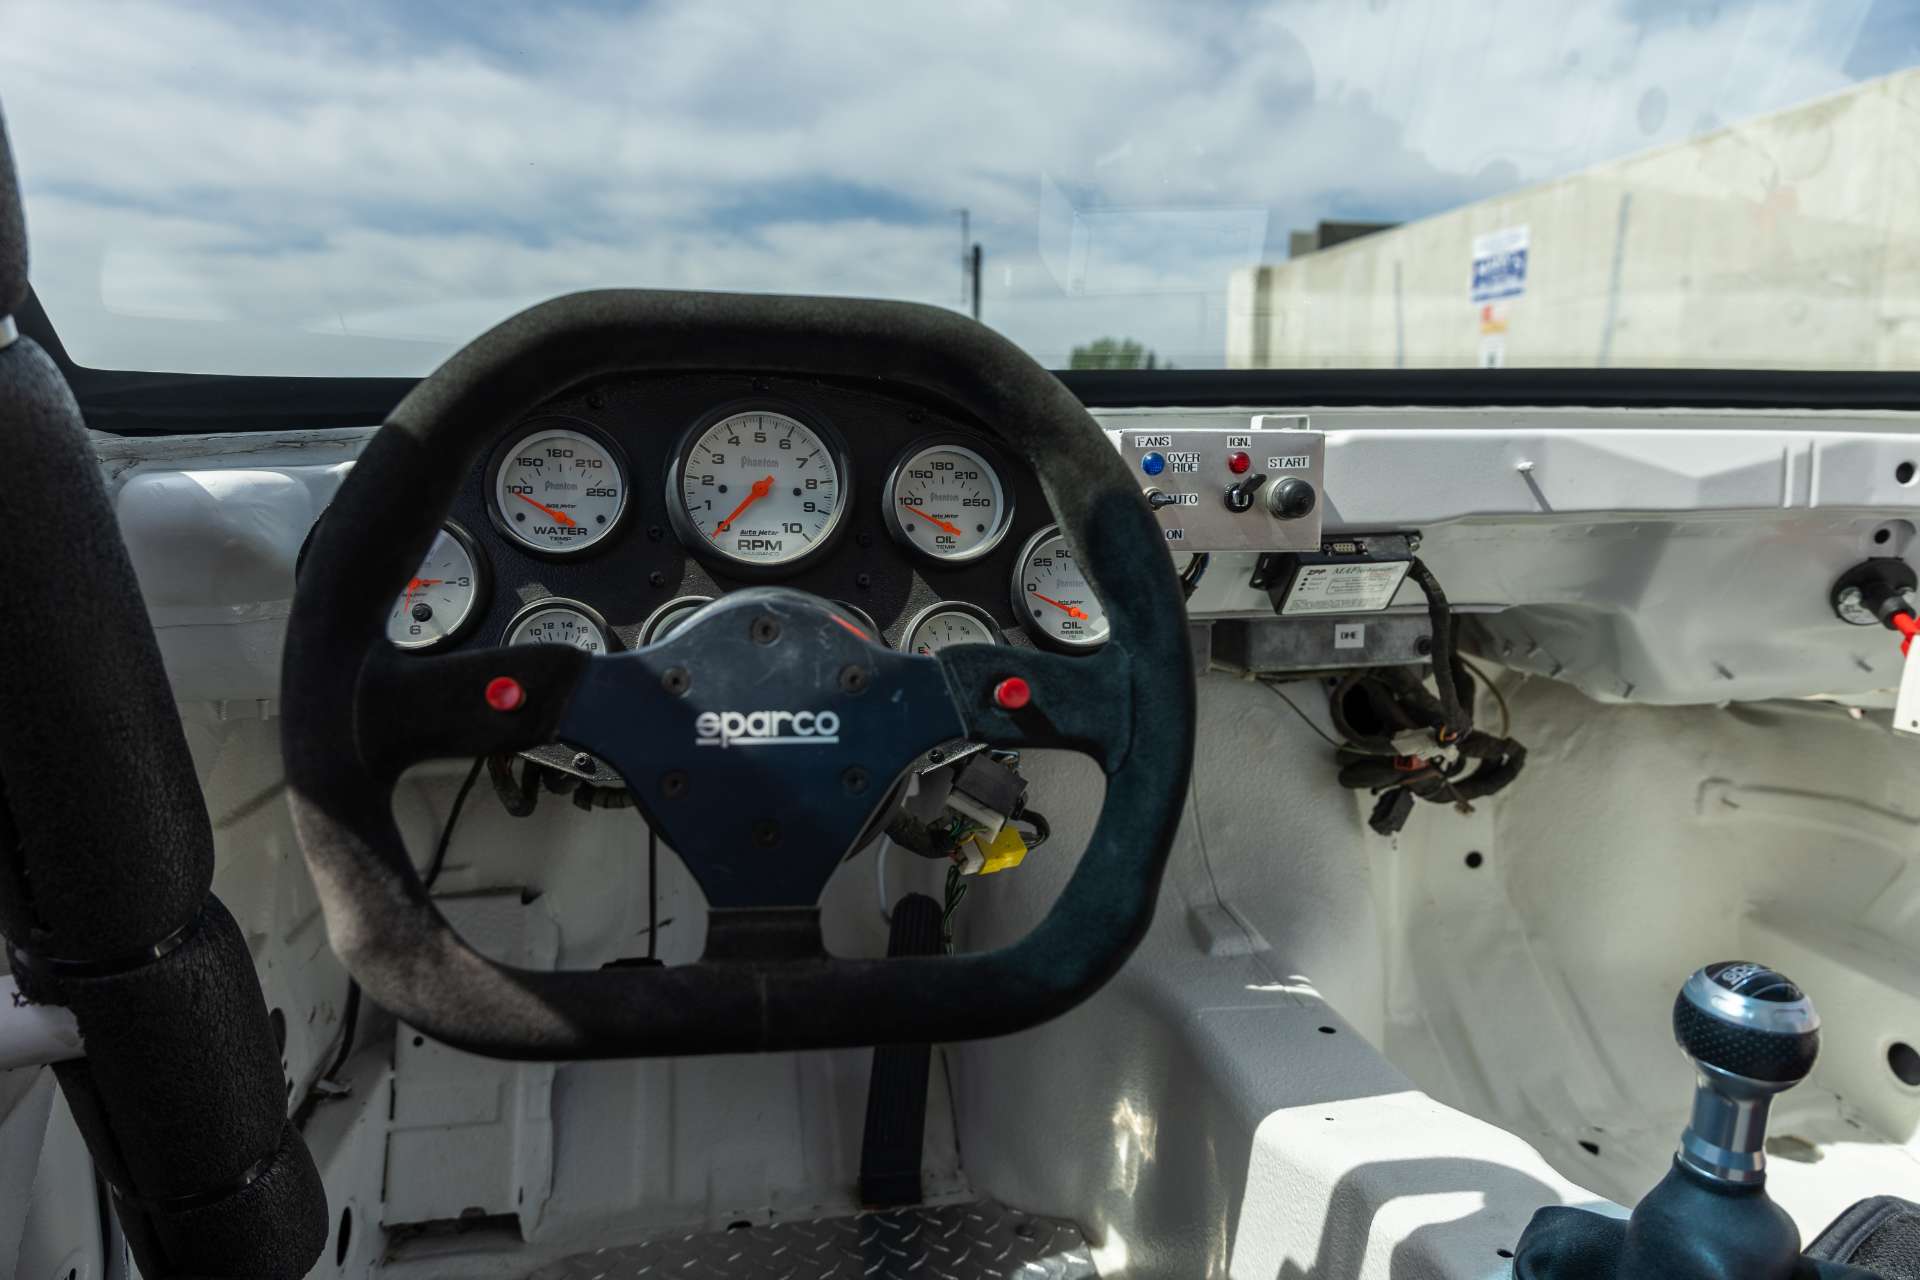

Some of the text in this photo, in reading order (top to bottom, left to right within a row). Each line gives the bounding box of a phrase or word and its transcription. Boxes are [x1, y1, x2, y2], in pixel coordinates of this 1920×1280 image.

[728, 435, 741, 446] 4
[754, 432, 767, 443] 5
[1136, 436, 1170, 447] FANS
[1229, 437, 1251, 448] IGN.
[779, 439, 791, 450] 6
[546, 448, 574, 458] 180
[1167, 453, 1200, 463] OVER
[516, 457, 544, 467] 150
[575, 459, 603, 469] 210
[711, 453, 725, 465] 3
[796, 457, 808, 468] 7
[1269, 457, 1308, 468] START
[930, 461, 954, 471] 180
[1172, 463, 1197, 473] RIDE
[909, 470, 933, 479] 150
[954, 471, 978, 480] 210
[702, 475, 714, 486] 2
[805, 479, 817, 490] 8
[506, 485, 533, 495] 100
[586, 488, 617, 498] 250
[899, 497, 923, 506] 100
[962, 498, 991, 507] 250
[1167, 494, 1198, 505] AUTO
[704, 500, 712, 511] 1
[803, 502, 816, 513] 9
[533, 526, 588, 536] WATER
[717, 521, 731, 532] 0
[782, 522, 803, 534] 10
[935, 535, 956, 544] OIL
[1166, 530, 1184, 540] ON
[737, 539, 783, 551] RPM
[1033, 558, 1053, 567] 25
[458, 577, 470, 588] 3
[1027, 583, 1037, 592] 0
[409, 624, 422, 635] 6
[542, 622, 555, 630] 12
[561, 621, 573, 629] 14
[577, 626, 588, 634] 16
[1062, 621, 1082, 630] OIL
[529, 628, 542, 637] 10
[695, 710, 840, 748] sparco
